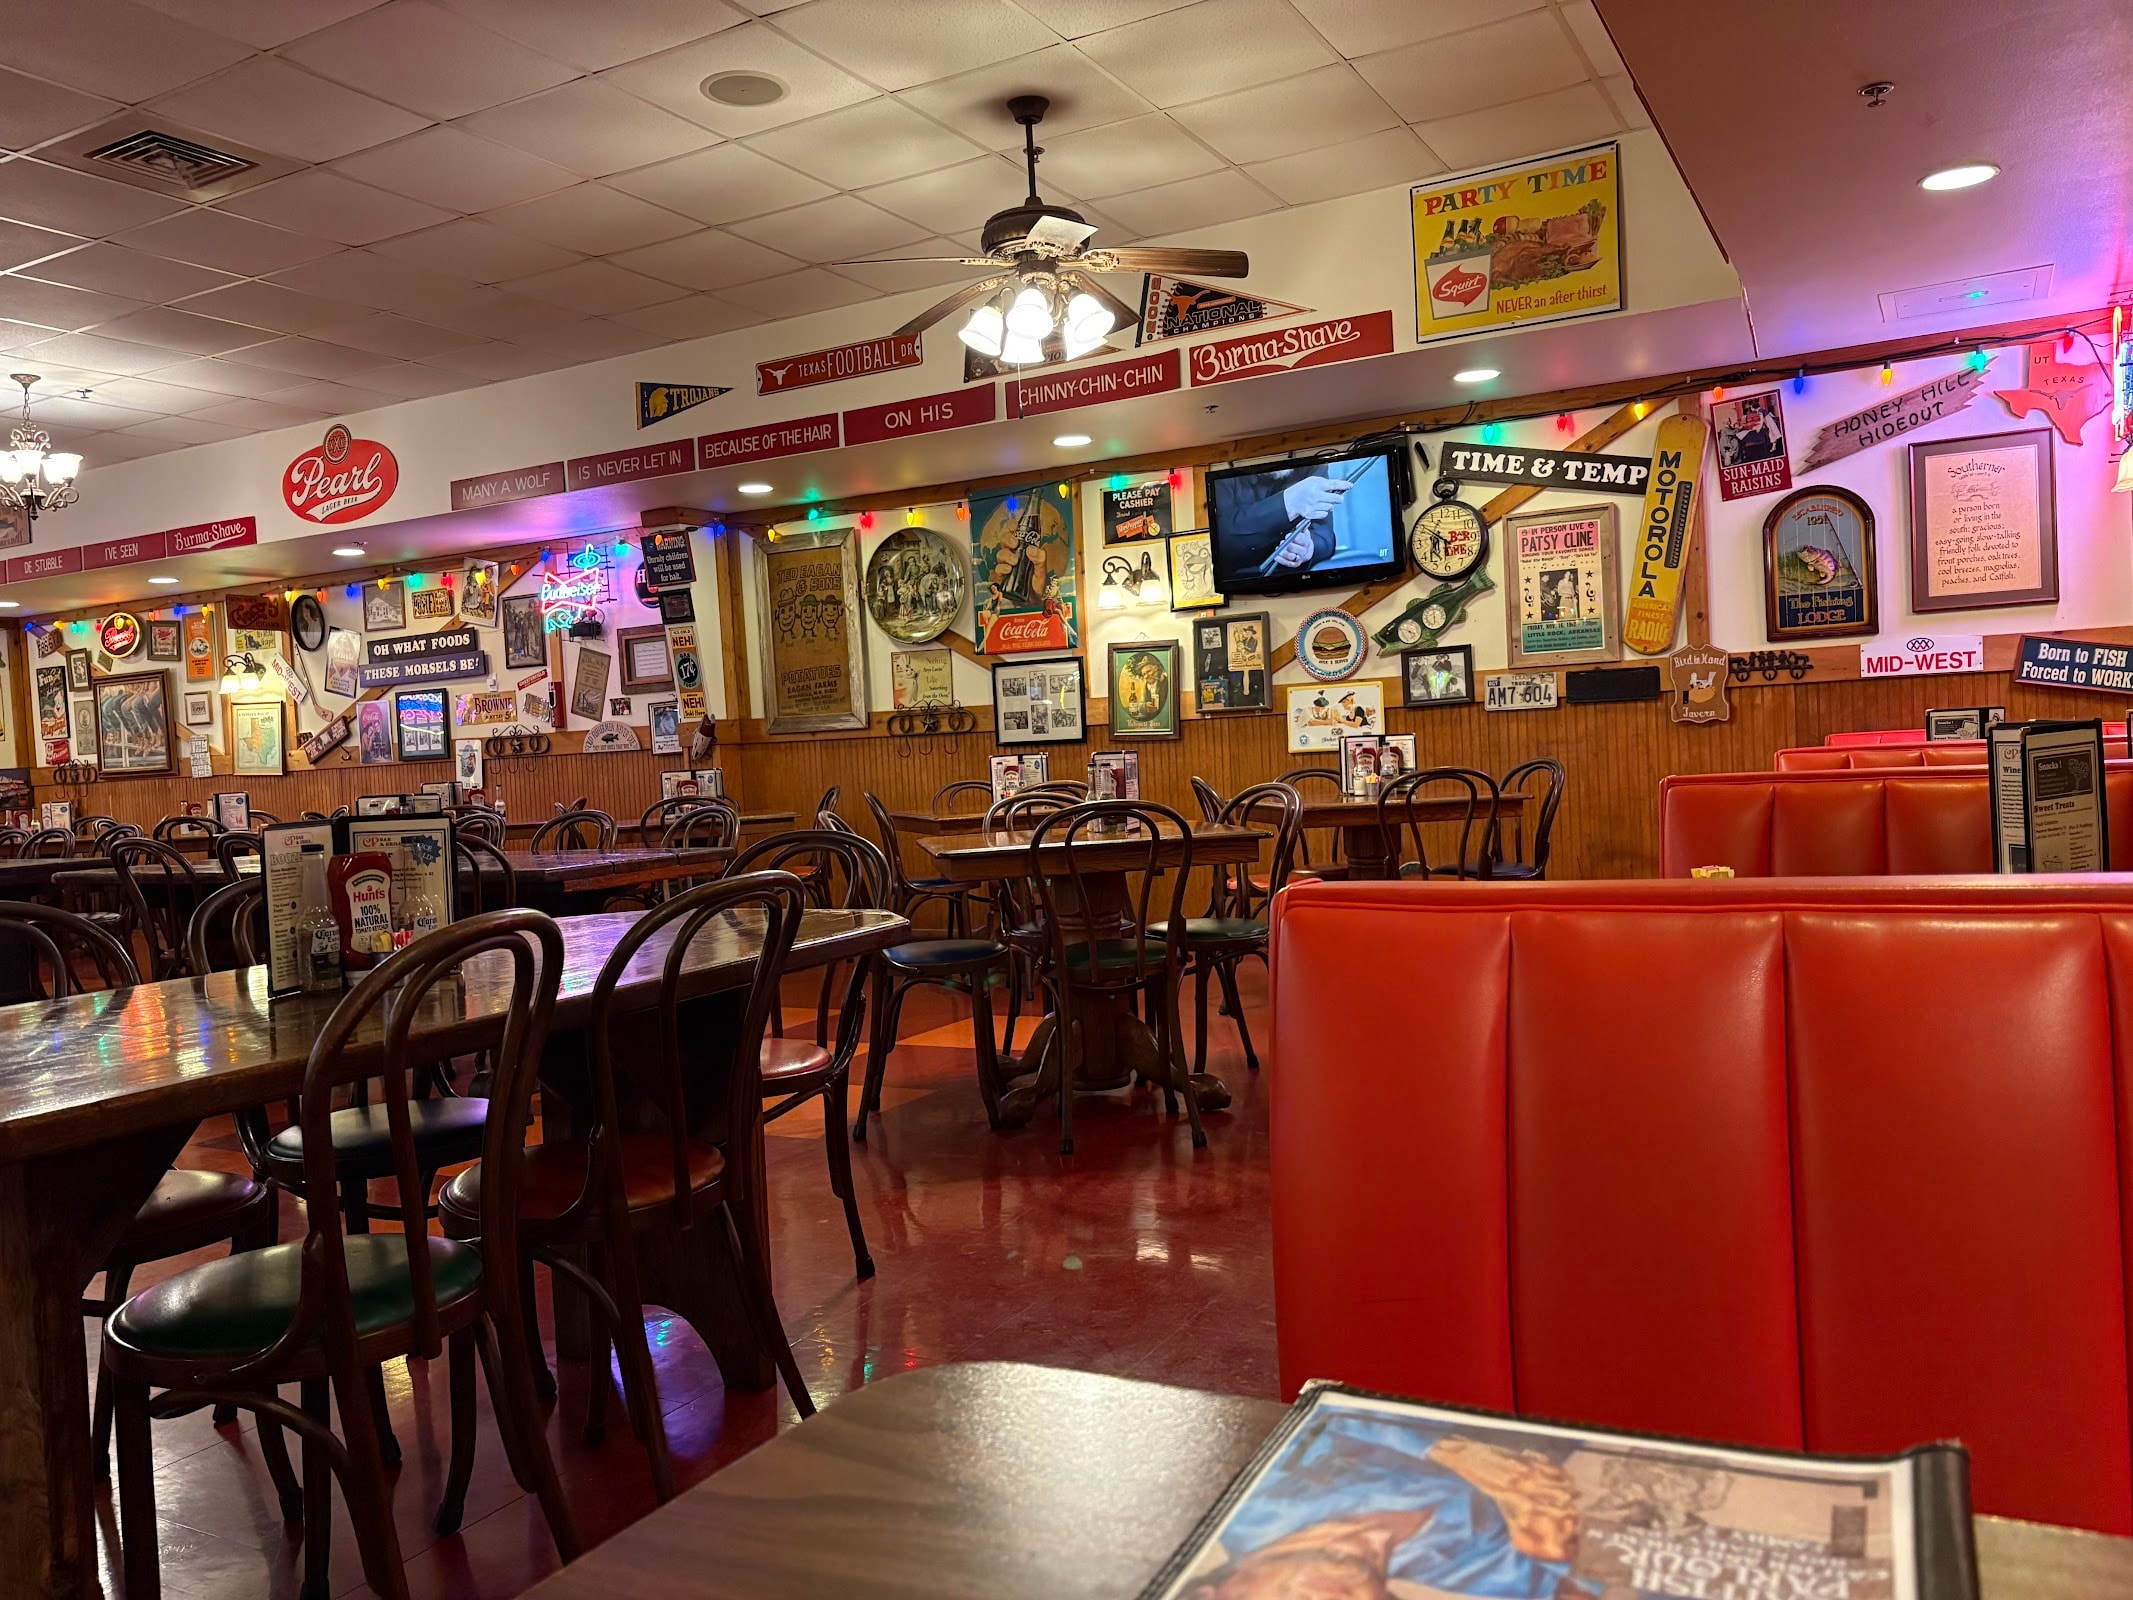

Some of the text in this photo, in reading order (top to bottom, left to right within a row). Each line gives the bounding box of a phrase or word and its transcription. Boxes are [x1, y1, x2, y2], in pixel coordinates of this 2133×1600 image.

[1424, 160, 1607, 217] PARTY TIME
[1439, 275, 1483, 298] Squirt
[1496, 284, 1607, 315] NEVER an after thirst
[1165, 300, 1261, 329] NATIONAL
[1173, 313, 1255, 334] CHAMPIONS
[799, 340, 913, 378] TEXAS FOOTBALL DR
[1193, 319, 1361, 382] Burma-Shave
[2034, 355, 2049, 365] UT
[1019, 363, 1164, 407] CHINNY-CHIN-CHIN
[2043, 375, 2086, 386] TEXAS
[669, 387, 720, 411] TROJANS
[1832, 372, 1970, 438] HONEY HILL
[884, 402, 954, 430] ON HIS
[1858, 401, 1945, 447] HIDEOUT
[705, 423, 832, 459] BECAUSE OF THE HAIR
[578, 448, 682, 481] IS NEVER LET IN
[1451, 450, 1648, 486] TIME & TEMP
[1723, 459, 1785, 481] SUN-MAID
[1947, 458, 2006, 478] Southerner
[291, 452, 383, 507] Pearl
[462, 472, 550, 501] MANY A WOLF
[1731, 472, 1782, 495] RAISINS
[1112, 487, 1161, 502] PLEASE PAY
[1119, 497, 1154, 510] CASHIER
[321, 502, 341, 514] LAGER
[1440, 508, 1451, 519] 12
[1953, 510, 2001, 524] or living in the
[1958, 504, 1982, 515] person
[1983, 501, 2000, 511] born
[1463, 518, 1474, 530] 10
[1540, 524, 1567, 534] PERSON
[1569, 522, 1585, 530] LIVE
[1637, 450, 1682, 598] MOTOROLA
[174, 521, 247, 551] Burma-Shave
[1416, 539, 1422, 550] 3
[1448, 530, 1470, 543] BAR
[1470, 531, 1477, 542] 9
[1521, 530, 1594, 553] PATSY CLINE
[105, 543, 139, 561] I'VE SEEN
[665, 552, 689, 561] children
[1421, 552, 1428, 561] 4
[1467, 545, 1474, 557] 8
[1939, 540, 2019, 556] friendly folk devoted to
[24, 556, 63, 574] DE STUBBLE
[653, 560, 686, 573] will be used
[1444, 561, 1451, 573] 6
[1458, 557, 1464, 567] 7
[1937, 552, 2001, 567] front oak
[660, 573, 669, 582] for
[776, 563, 842, 584] TED EAGAN
[1937, 565, 1952, 576] cool
[1972, 572, 1987, 583] and
[541, 582, 601, 601] Budweiser
[795, 577, 842, 597] & SONS
[1789, 595, 1854, 610] The Fishing
[1797, 609, 1846, 625] LODGE
[1000, 618, 1051, 641] Coca-Cola
[1568, 627, 1600, 635] ARKANSAS
[1628, 619, 1668, 643] RADIO
[373, 634, 470, 656] OH WHAT FOODS
[672, 635, 695, 647] NEHI
[1673, 653, 1726, 668] Bird in Hand
[1866, 651, 1976, 673] MID-WEST
[2038, 643, 2128, 668] Born to FISH
[364, 658, 479, 681] THESE MORSELS BE!
[680, 660, 697, 680] 17¢
[781, 665, 842, 686] POTATOES
[2022, 661, 2068, 682] Forced
[2072, 664, 2086, 684] to
[271, 659, 302, 700] MID-WEST
[814, 680, 838, 689] FARMS
[682, 697, 706, 709] NEHI
[1488, 684, 1552, 705] AM7 604
[474, 697, 513, 715] BROWNIE
[1682, 706, 1716, 717] Tavern
[2034, 801, 2075, 813] Sweet Treats
[362, 836, 380, 848] CP
[353, 889, 386, 903] Hunt's
[360, 904, 381, 917] 100%
[354, 914, 389, 929] NATURAL
[355, 926, 372, 934] TOMATO
